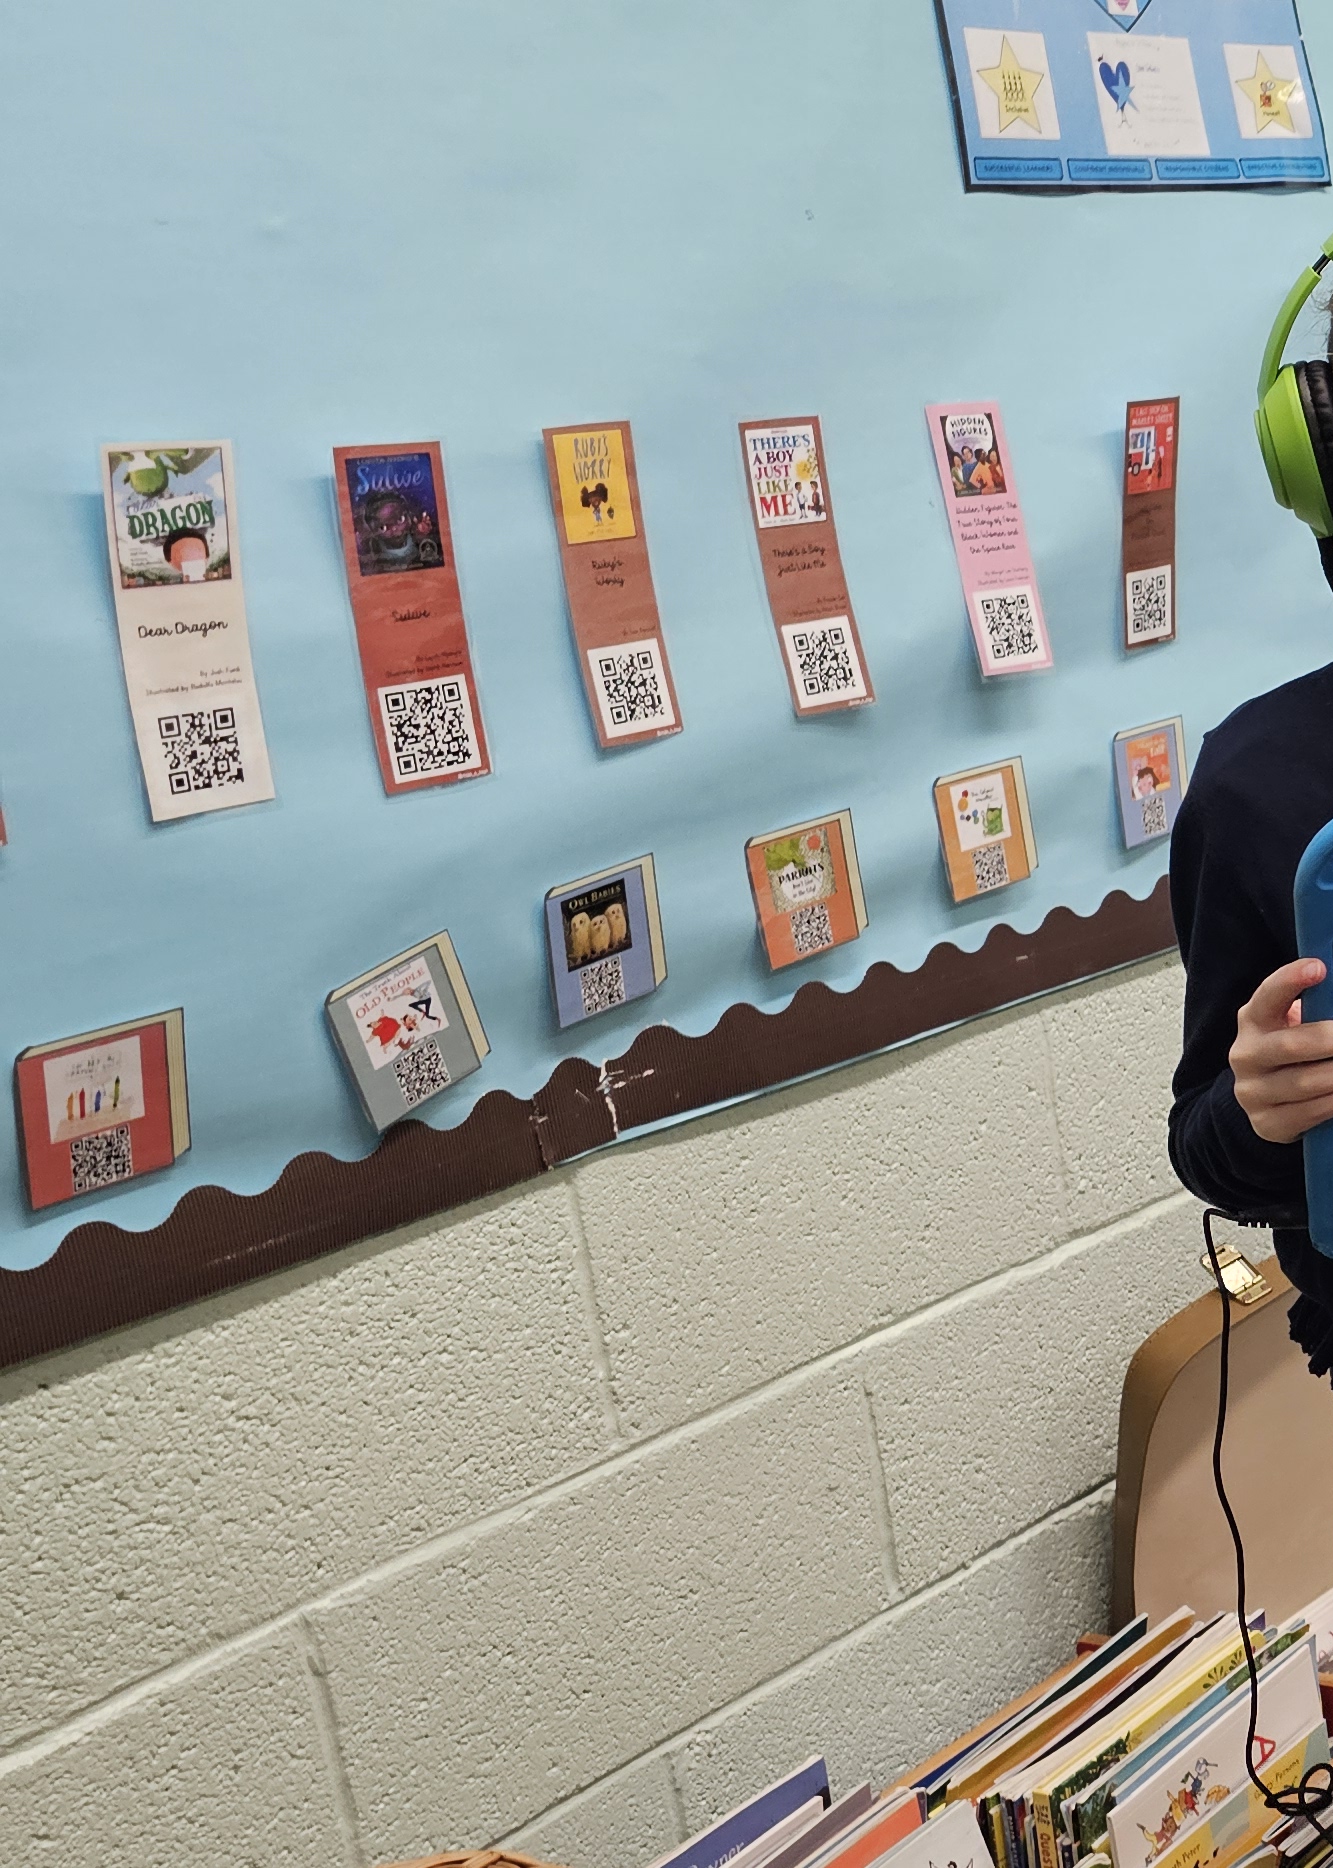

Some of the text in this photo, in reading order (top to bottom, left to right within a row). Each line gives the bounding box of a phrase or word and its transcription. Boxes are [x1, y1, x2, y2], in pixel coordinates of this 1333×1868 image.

[950, 416, 984, 428] HIDDEN
[952, 427, 988, 439] FIGURES
[749, 434, 810, 451] THERE'S
[753, 449, 794, 465] A BOY
[356, 465, 424, 495] Sulwe
[755, 464, 791, 480] JUST
[757, 479, 793, 494] LIKE
[759, 493, 796, 519] ME
[126, 500, 215, 540] DRAGON
[138, 620, 228, 638] Dear Dragon
[568, 885, 622, 909] OWL BABIES
[355, 967, 426, 1019] OLD PEOPLE
